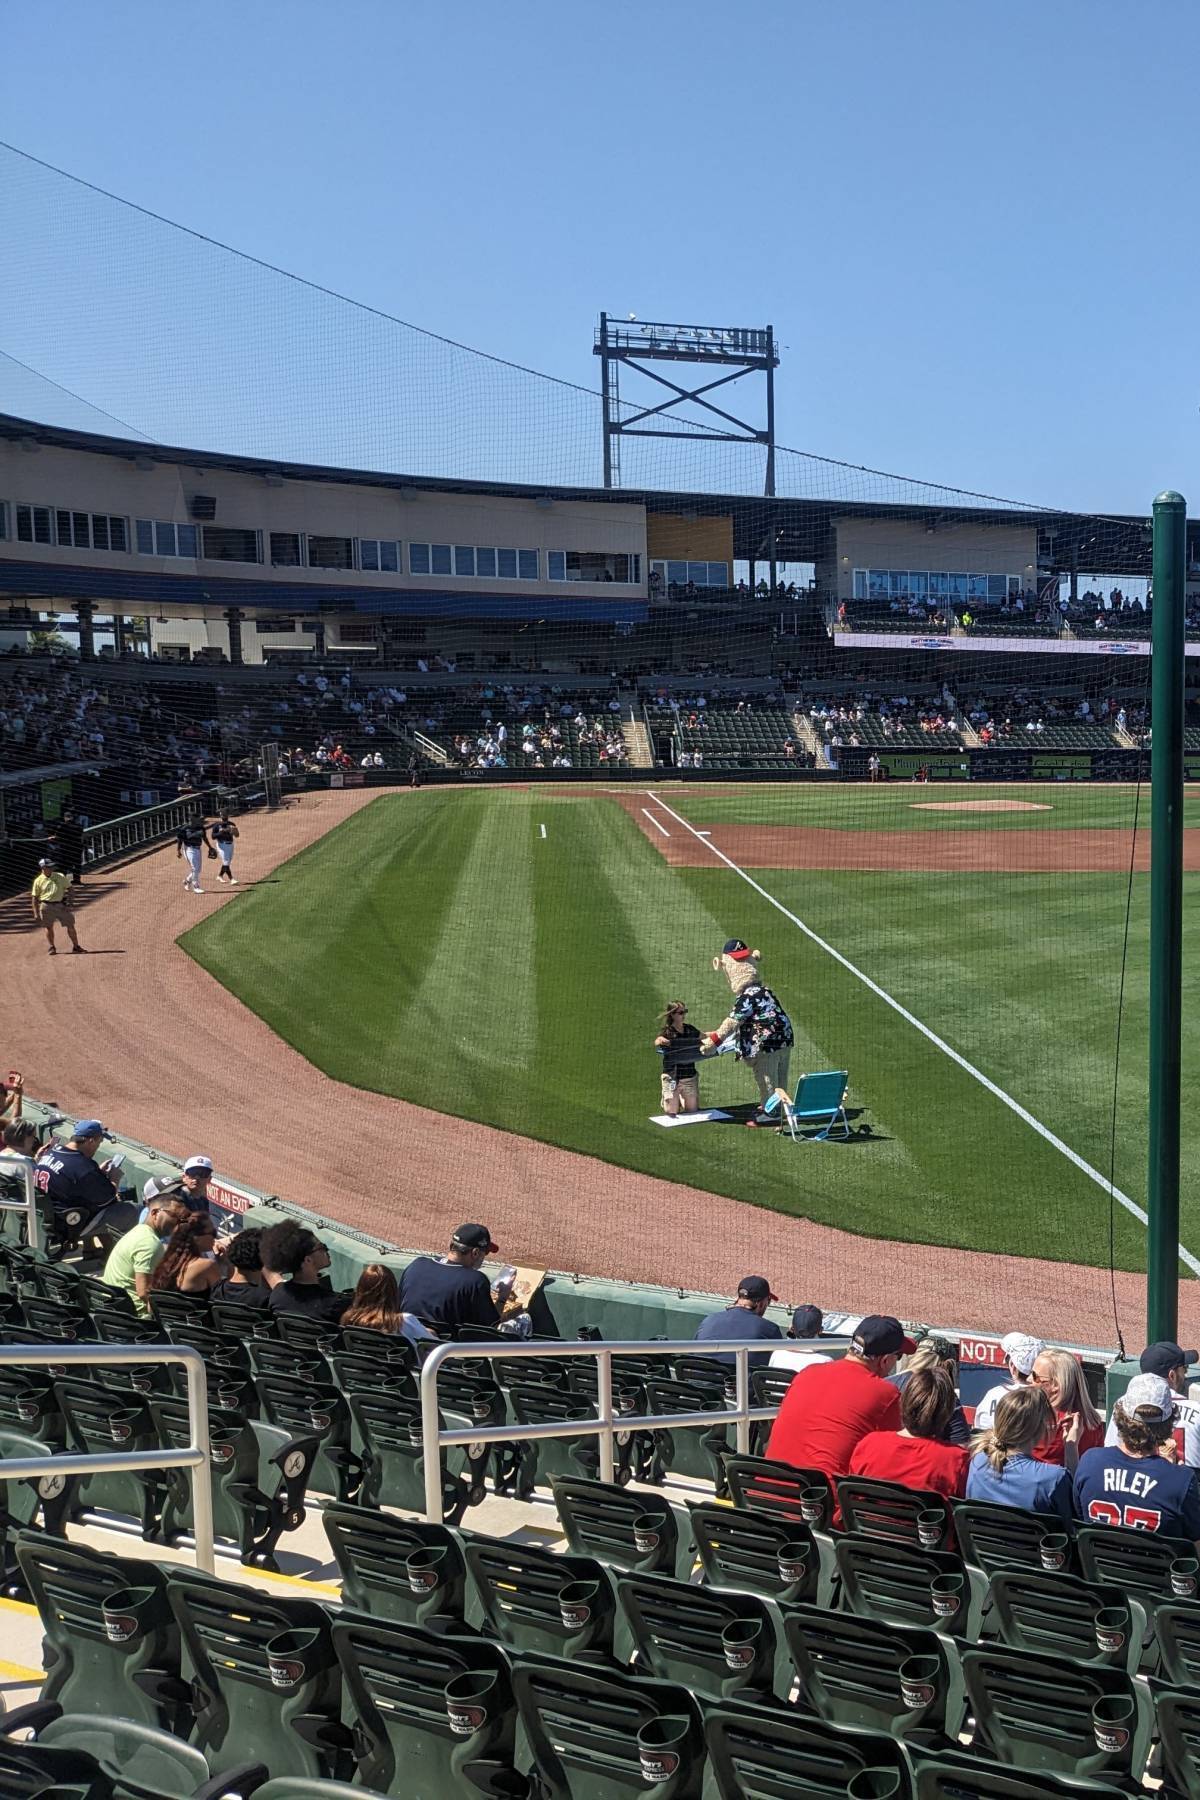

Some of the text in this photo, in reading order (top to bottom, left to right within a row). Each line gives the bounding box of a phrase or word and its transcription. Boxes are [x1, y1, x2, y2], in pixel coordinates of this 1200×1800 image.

[206, 1183, 248, 1212] NOT AN EXIT
[960, 1340, 998, 1363] NOT
[1103, 1468, 1158, 1499] RILEY
